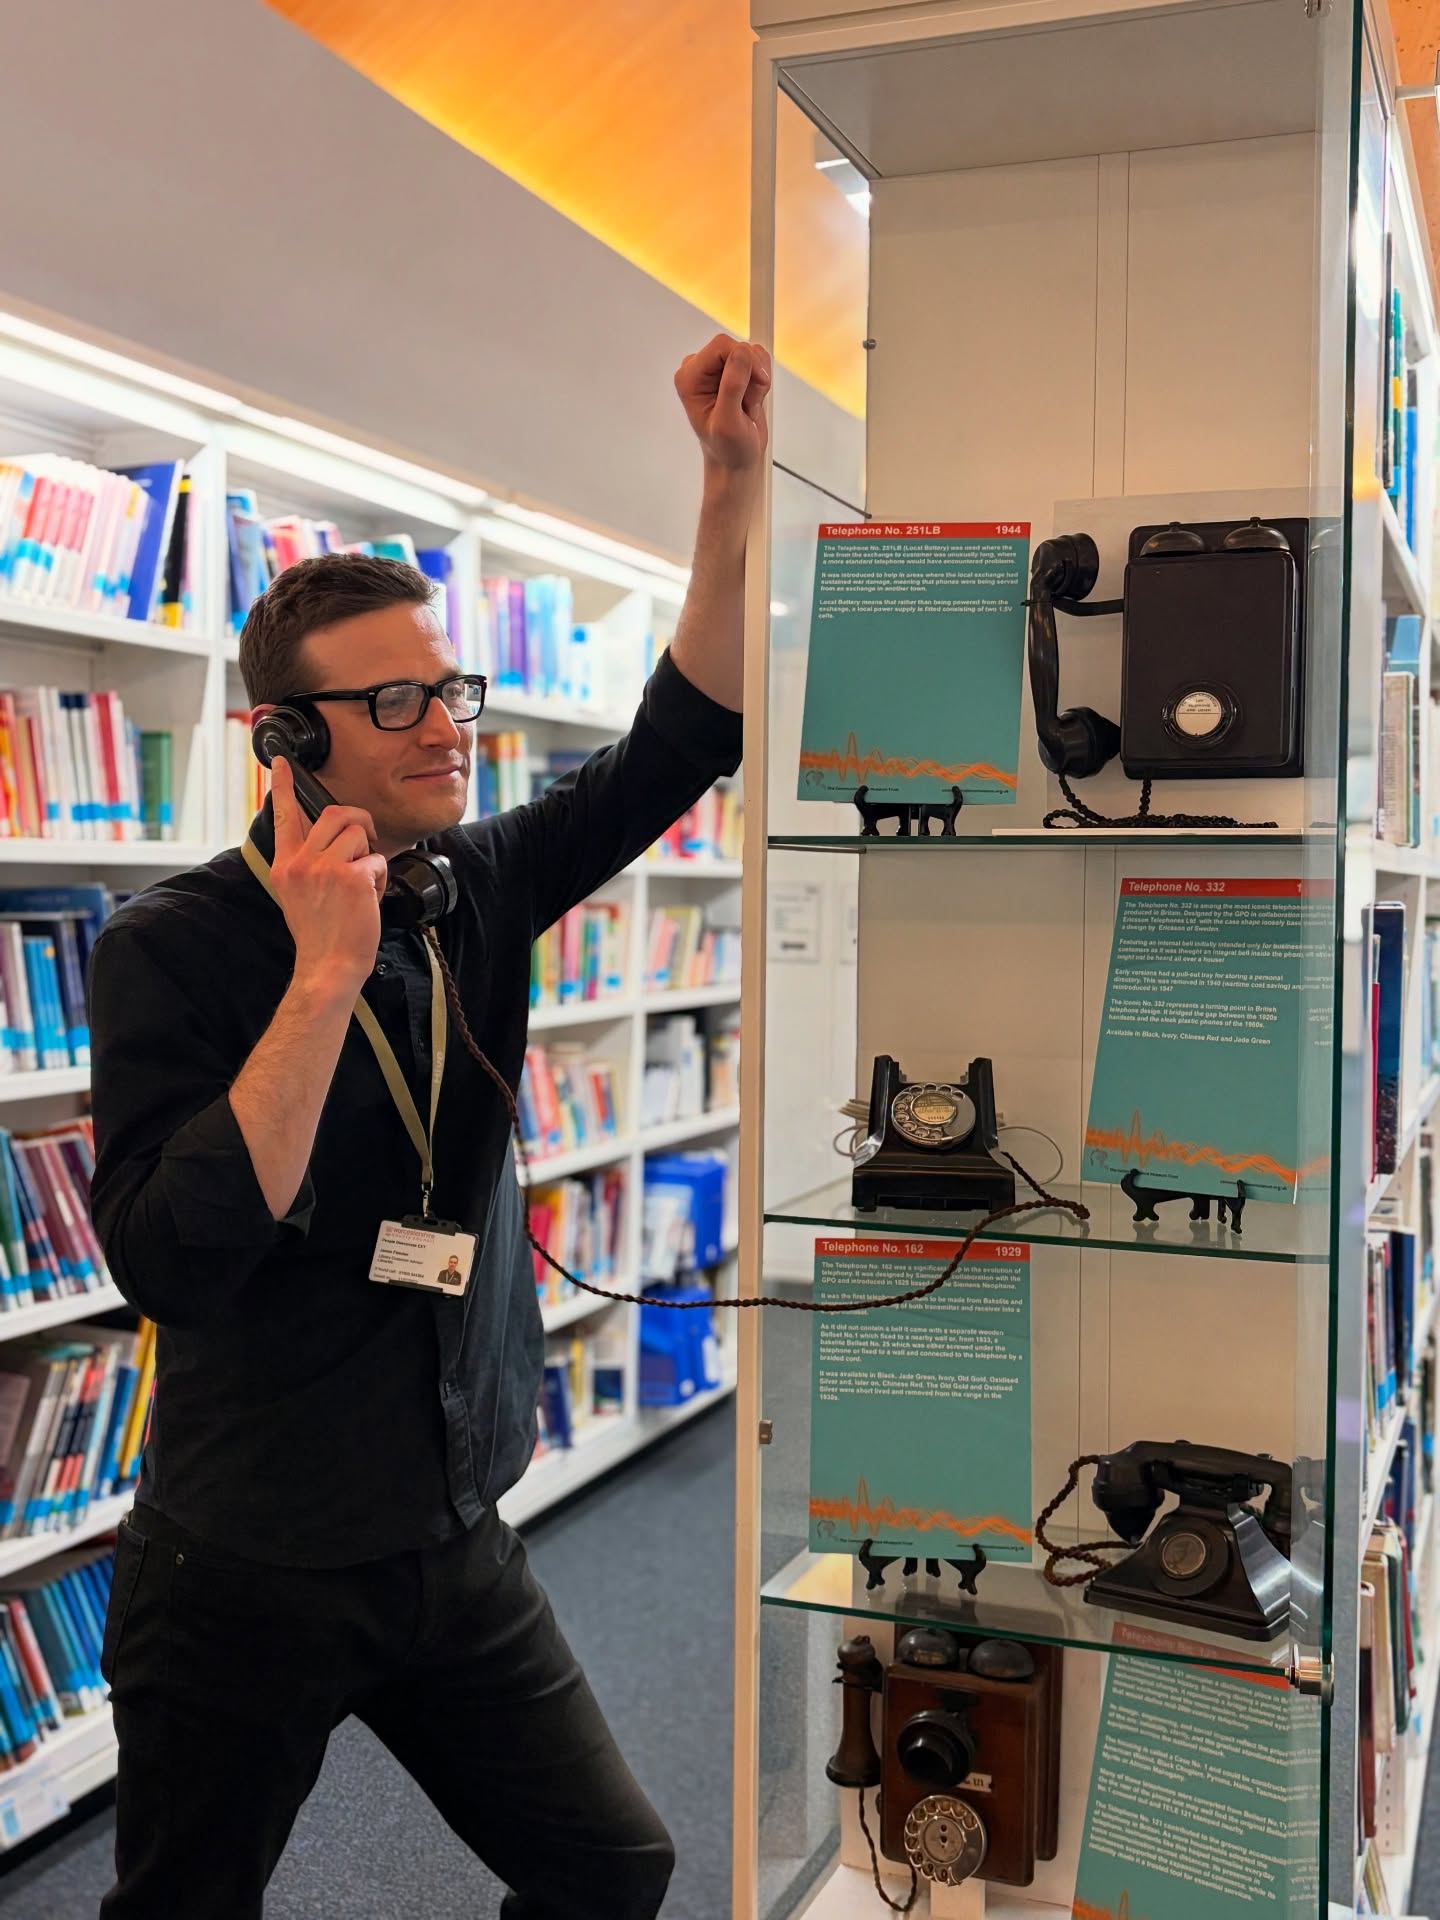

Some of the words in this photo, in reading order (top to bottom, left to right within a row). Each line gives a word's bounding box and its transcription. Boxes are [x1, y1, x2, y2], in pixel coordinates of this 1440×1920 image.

[825, 526, 882, 537] Telephone
[884, 526, 904, 535] No.
[906, 526, 941, 534] 251LB
[995, 526, 1022, 534] 1944
[1127, 882, 1183, 894] Telephone
[1184, 883, 1204, 892] No.
[1205, 883, 1226, 892] 332
[1166, 1002, 1200, 1010] represents
[822, 1242, 880, 1254] Telephone
[882, 1244, 901, 1253] No.
[904, 1244, 924, 1254] 162
[995, 1247, 1022, 1256] 1929
